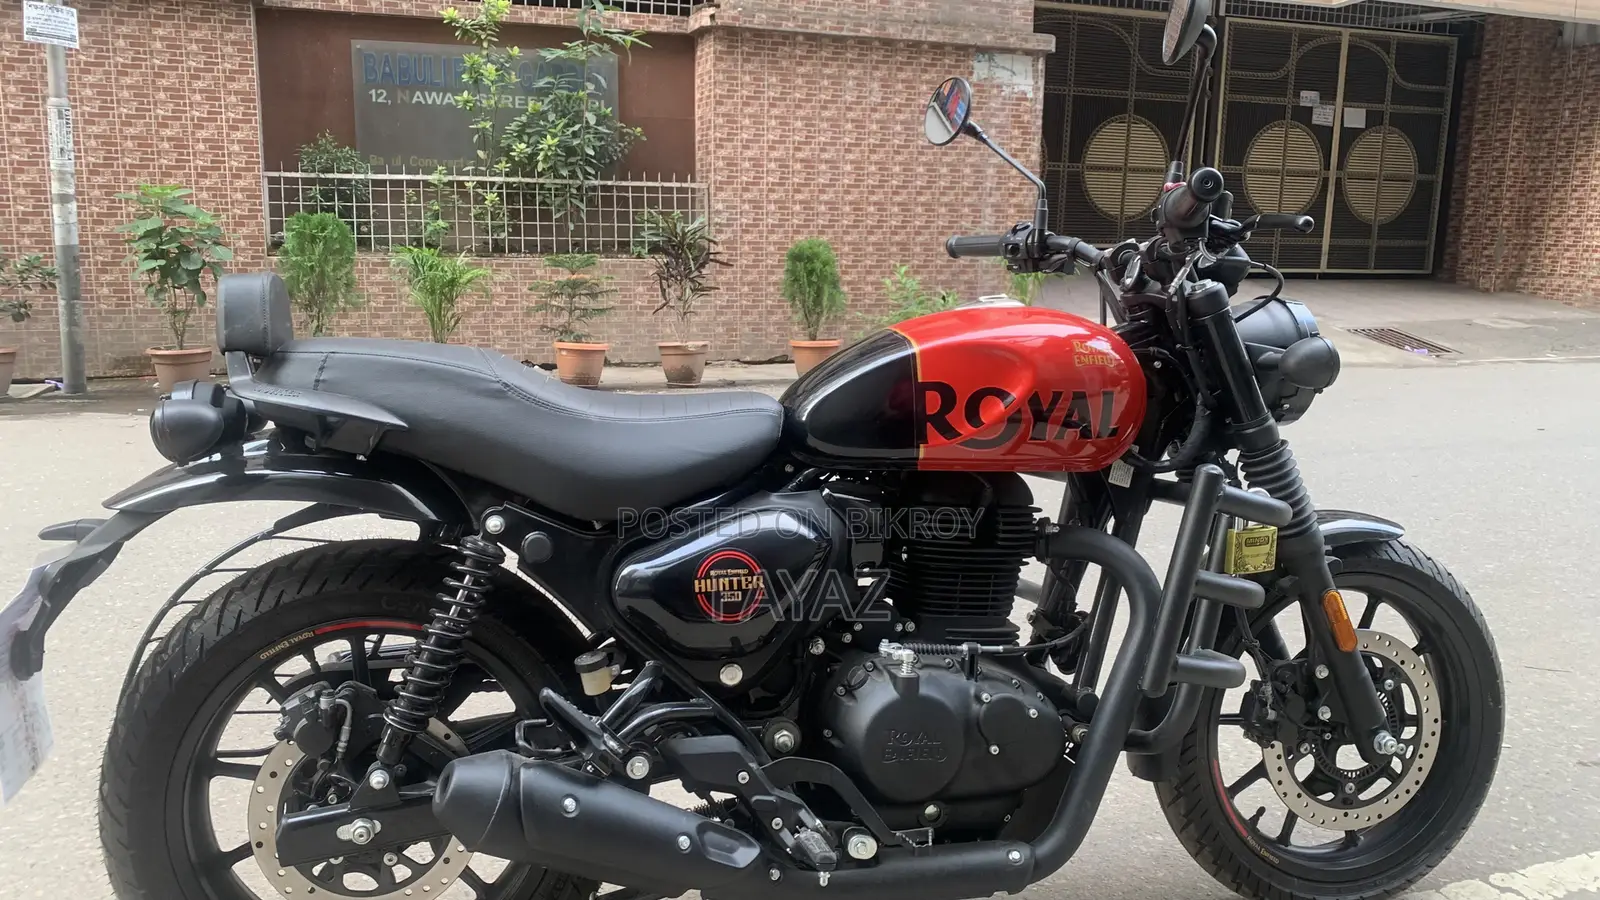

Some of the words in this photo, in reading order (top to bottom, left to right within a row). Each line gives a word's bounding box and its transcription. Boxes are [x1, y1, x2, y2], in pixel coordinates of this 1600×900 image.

[368, 88, 392, 106] 12,
[396, 88, 467, 106] NAWA
[369, 154, 401, 167] Baul
[1074, 354, 1115, 367] ENFIELD
[918, 381, 1120, 450] ROYAL
[694, 576, 765, 593] HUNTER
[720, 590, 742, 602] 350
[288, 630, 315, 644] ROYAL
[259, 640, 290, 660] ENFIELD
